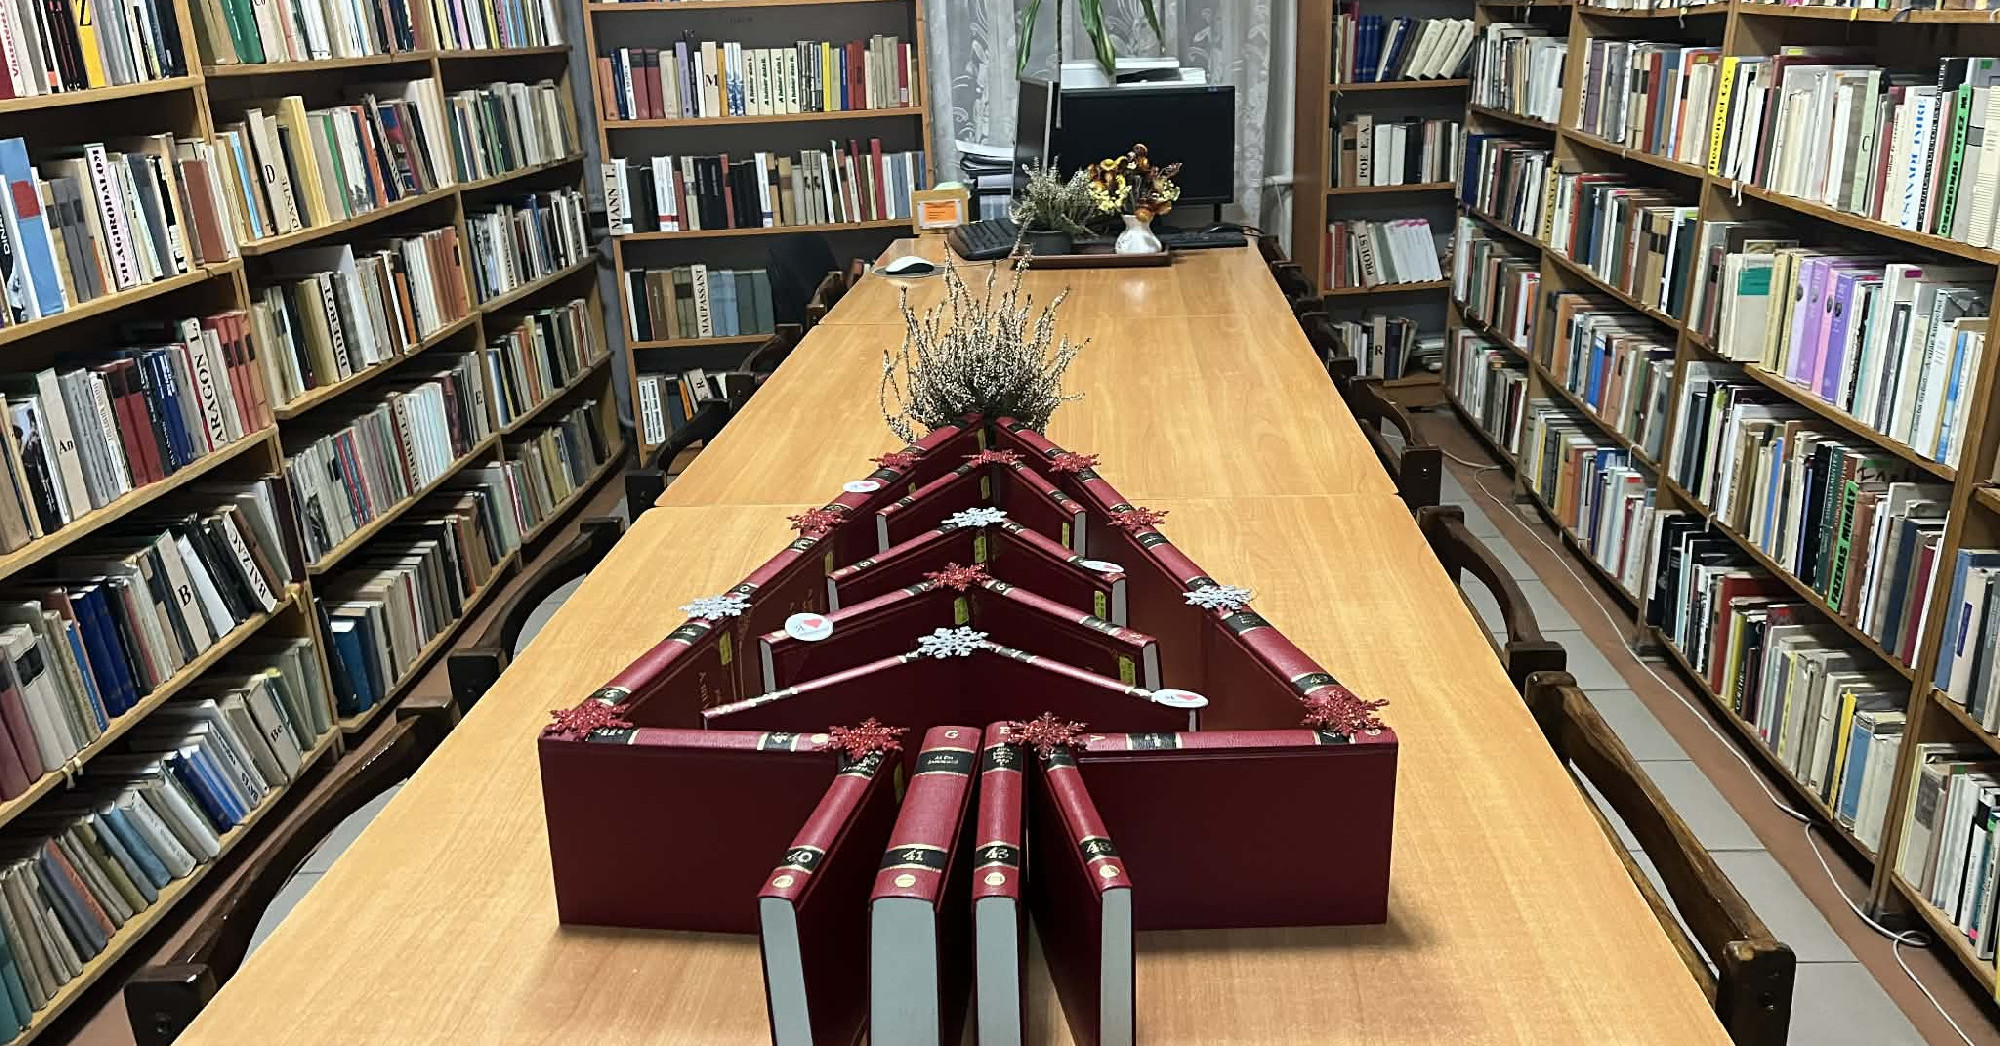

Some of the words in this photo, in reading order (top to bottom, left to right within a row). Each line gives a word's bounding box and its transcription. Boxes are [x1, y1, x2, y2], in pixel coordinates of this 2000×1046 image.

[705, 74, 719, 87] M
[264, 164, 275, 184] D
[604, 167, 617, 181] T.
[1359, 156, 1370, 179] POE
[607, 187, 622, 230] MANN
[1358, 234, 1376, 277] PROUST
[695, 268, 709, 335] MAUPASSANT
[188, 322, 201, 343] L.
[324, 282, 348, 369] DIDEROT
[1375, 345, 1383, 356] R
[196, 354, 226, 442] ARAGON
[475, 391, 483, 405] E
[59, 439, 74, 454] An
[232, 531, 268, 601] BALZAC
[1832, 546, 1849, 604] FAZEKAS
[178, 583, 192, 607] B
[270, 725, 283, 742] Be
[787, 850, 813, 863] 40
[902, 848, 925, 862] 41
